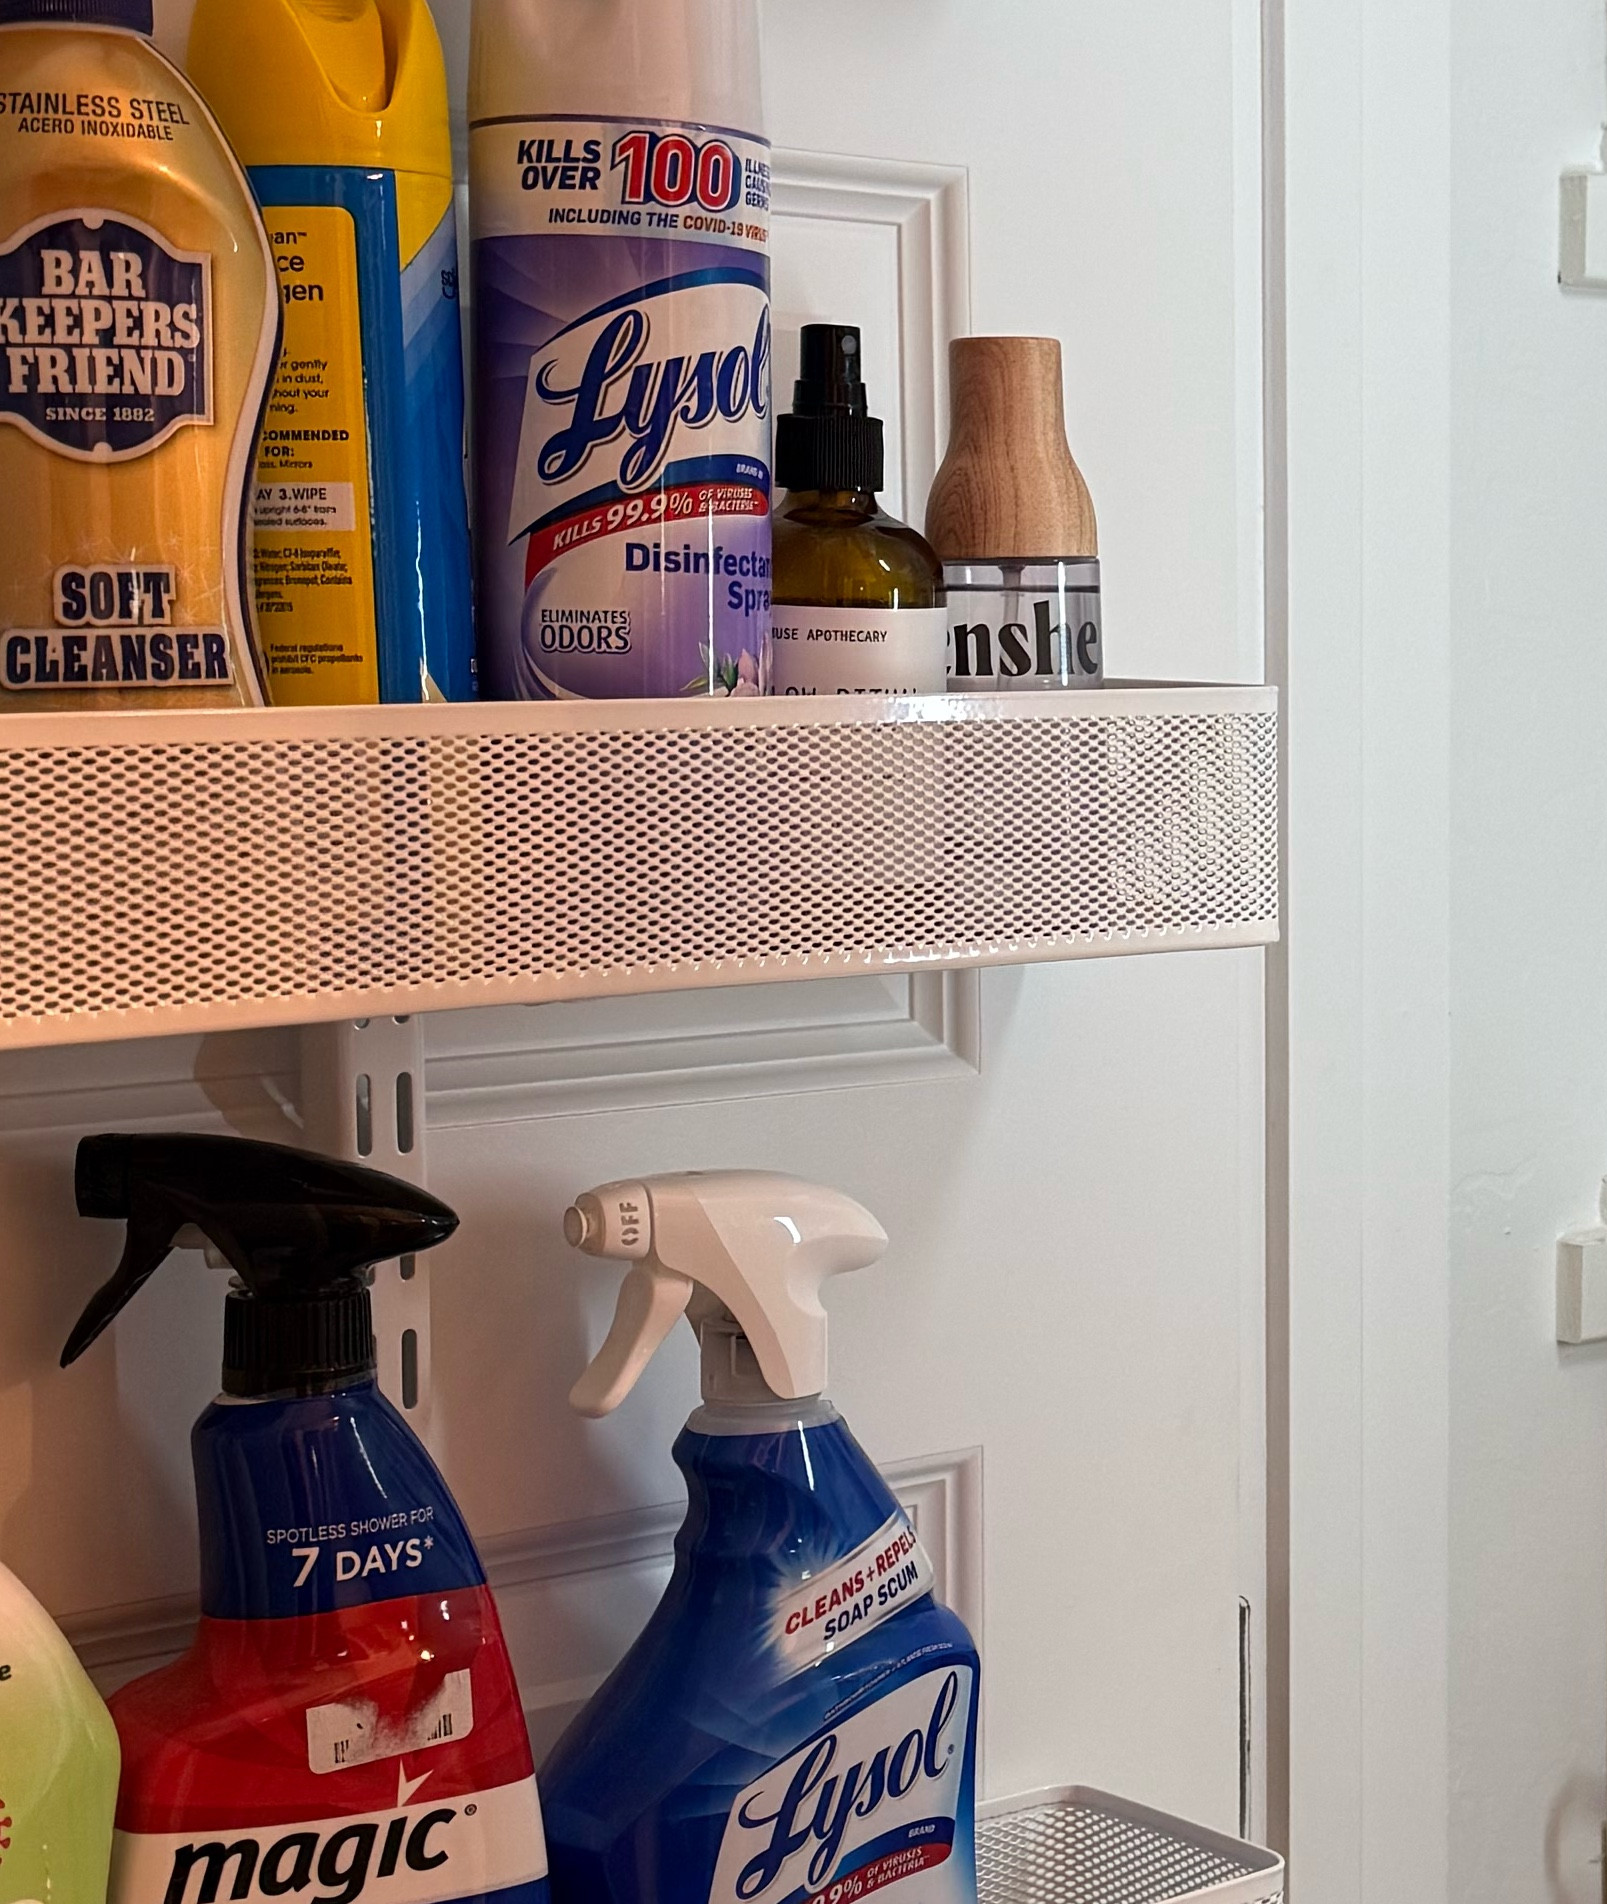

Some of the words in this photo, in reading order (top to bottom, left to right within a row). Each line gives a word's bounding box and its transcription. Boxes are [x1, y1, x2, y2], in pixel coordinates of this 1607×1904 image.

[0, 92, 121, 118] STAINLESS
[129, 98, 190, 125] STEEL
[18, 117, 74, 134] ACERO
[81, 119, 173, 141] INOXIDABLE
[517, 139, 601, 164] KILLS
[610, 131, 738, 212] 100
[521, 165, 600, 190] OVER
[548, 208, 641, 226] INCLUDING
[647, 212, 678, 229] THE
[683, 215, 743, 238] COVID-19
[40, 249, 146, 297] BAR
[0, 297, 200, 349] KEEPERS
[6, 347, 185, 396] FRIEND
[46, 407, 106, 421] SINCE
[113, 407, 155, 421] 1882
[536, 303, 770, 489] Lysol
[263, 429, 349, 441] OMMENDED
[264, 446, 295, 457] FOR:
[553, 516, 601, 551] KILLS
[606, 492, 693, 531] 99.9%
[61, 571, 170, 621] SOFT
[728, 581, 771, 617] Spra
[541, 609, 627, 624] ELIMINATES
[806, 628, 888, 643] APOTHECARY
[540, 625, 629, 651] ODORS
[6, 633, 229, 684] CLEANSER
[619, 1202, 639, 1246] OFF
[266, 1524, 346, 1544] SPOTLESS
[351, 1512, 407, 1536] SHOWER
[410, 1506, 434, 1525] FOR
[291, 1547, 320, 1588] 7
[823, 1595, 874, 1641] SOAP
[878, 1560, 918, 1607] SCUM
[736, 1671, 958, 1900] Lysol
[883, 1846, 922, 1870] VIRUSES
